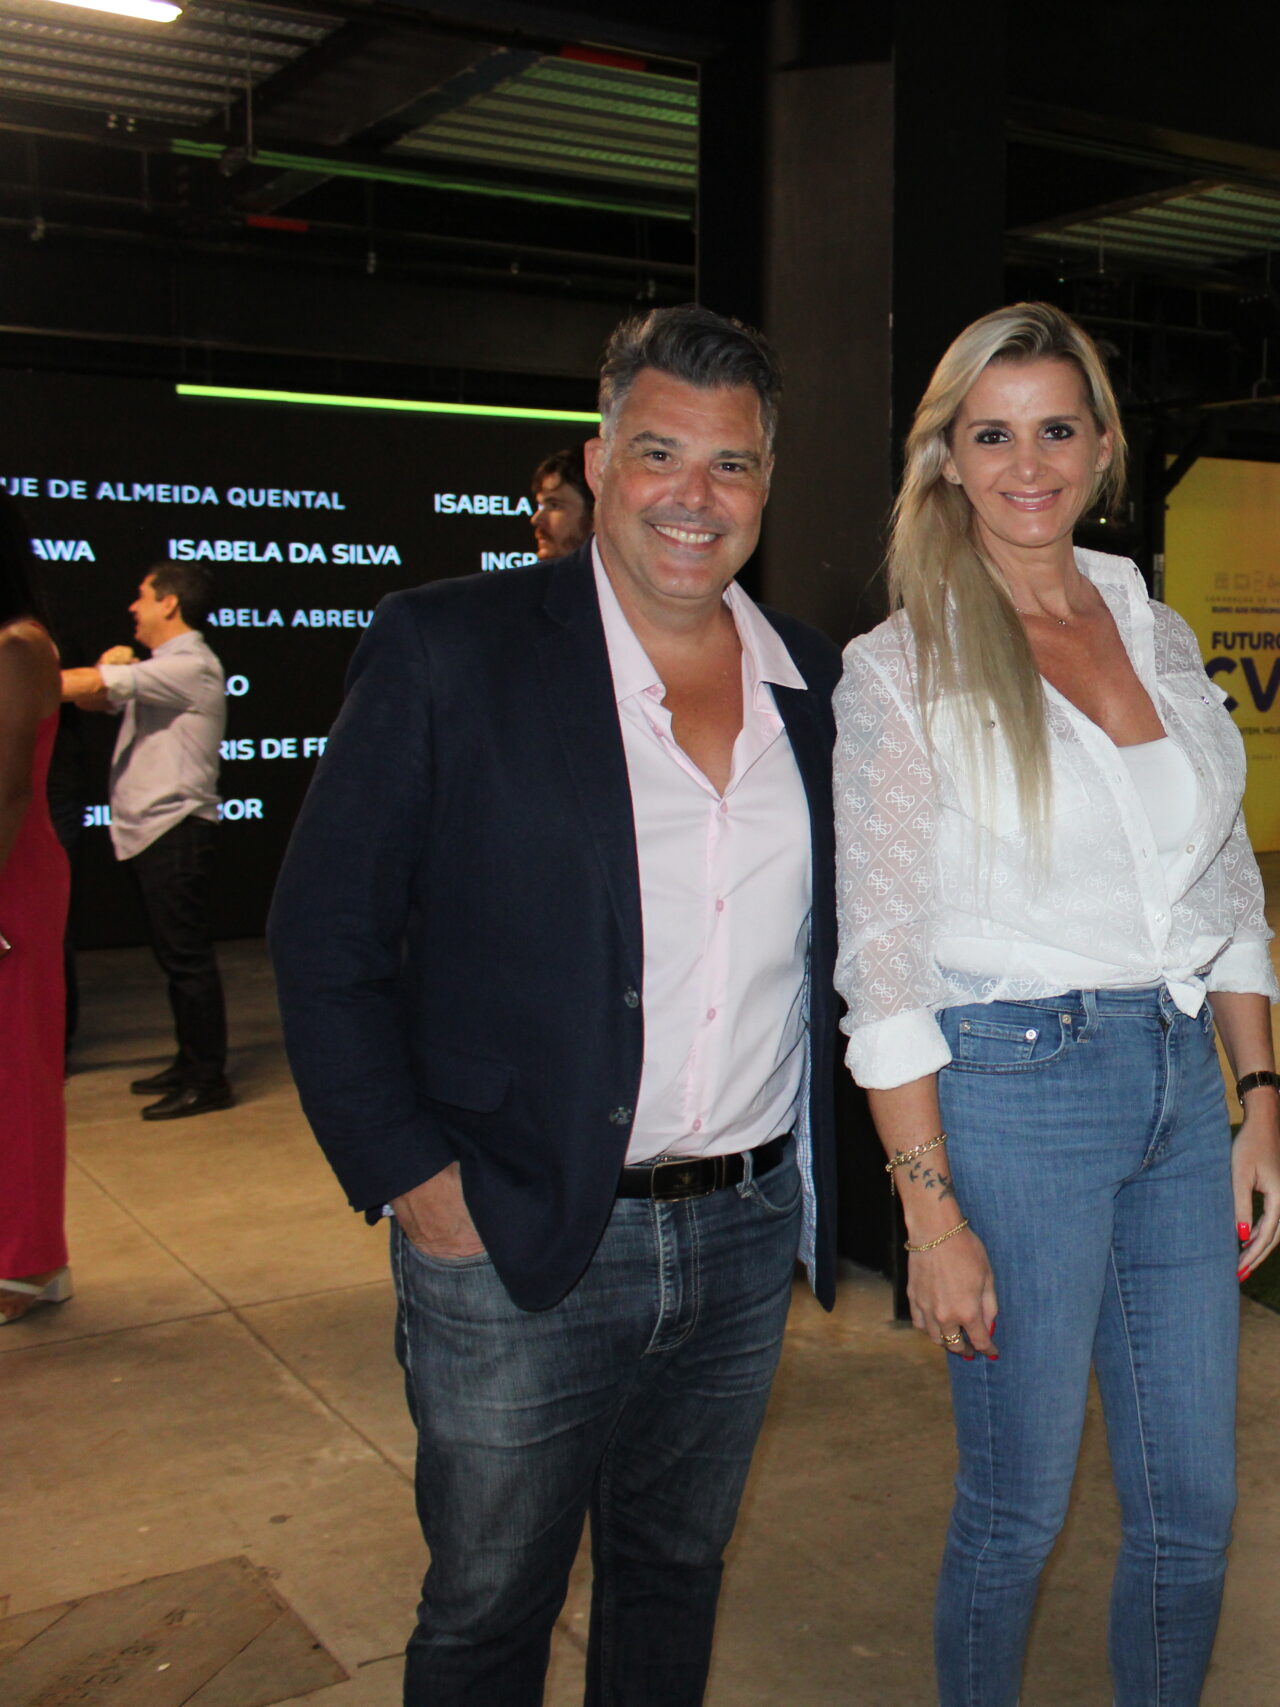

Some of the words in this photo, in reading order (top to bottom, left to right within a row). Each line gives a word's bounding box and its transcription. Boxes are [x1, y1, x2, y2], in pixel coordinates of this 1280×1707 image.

[47, 478, 88, 499] DE
[96, 481, 219, 504] ALMEIDA
[226, 486, 346, 510] QUENTAL
[433, 492, 533, 516] ISABELA
[167, 538, 283, 563] ISABELA
[288, 543, 327, 564] DA
[331, 544, 401, 565] SILVA
[260, 738, 298, 759] DE
